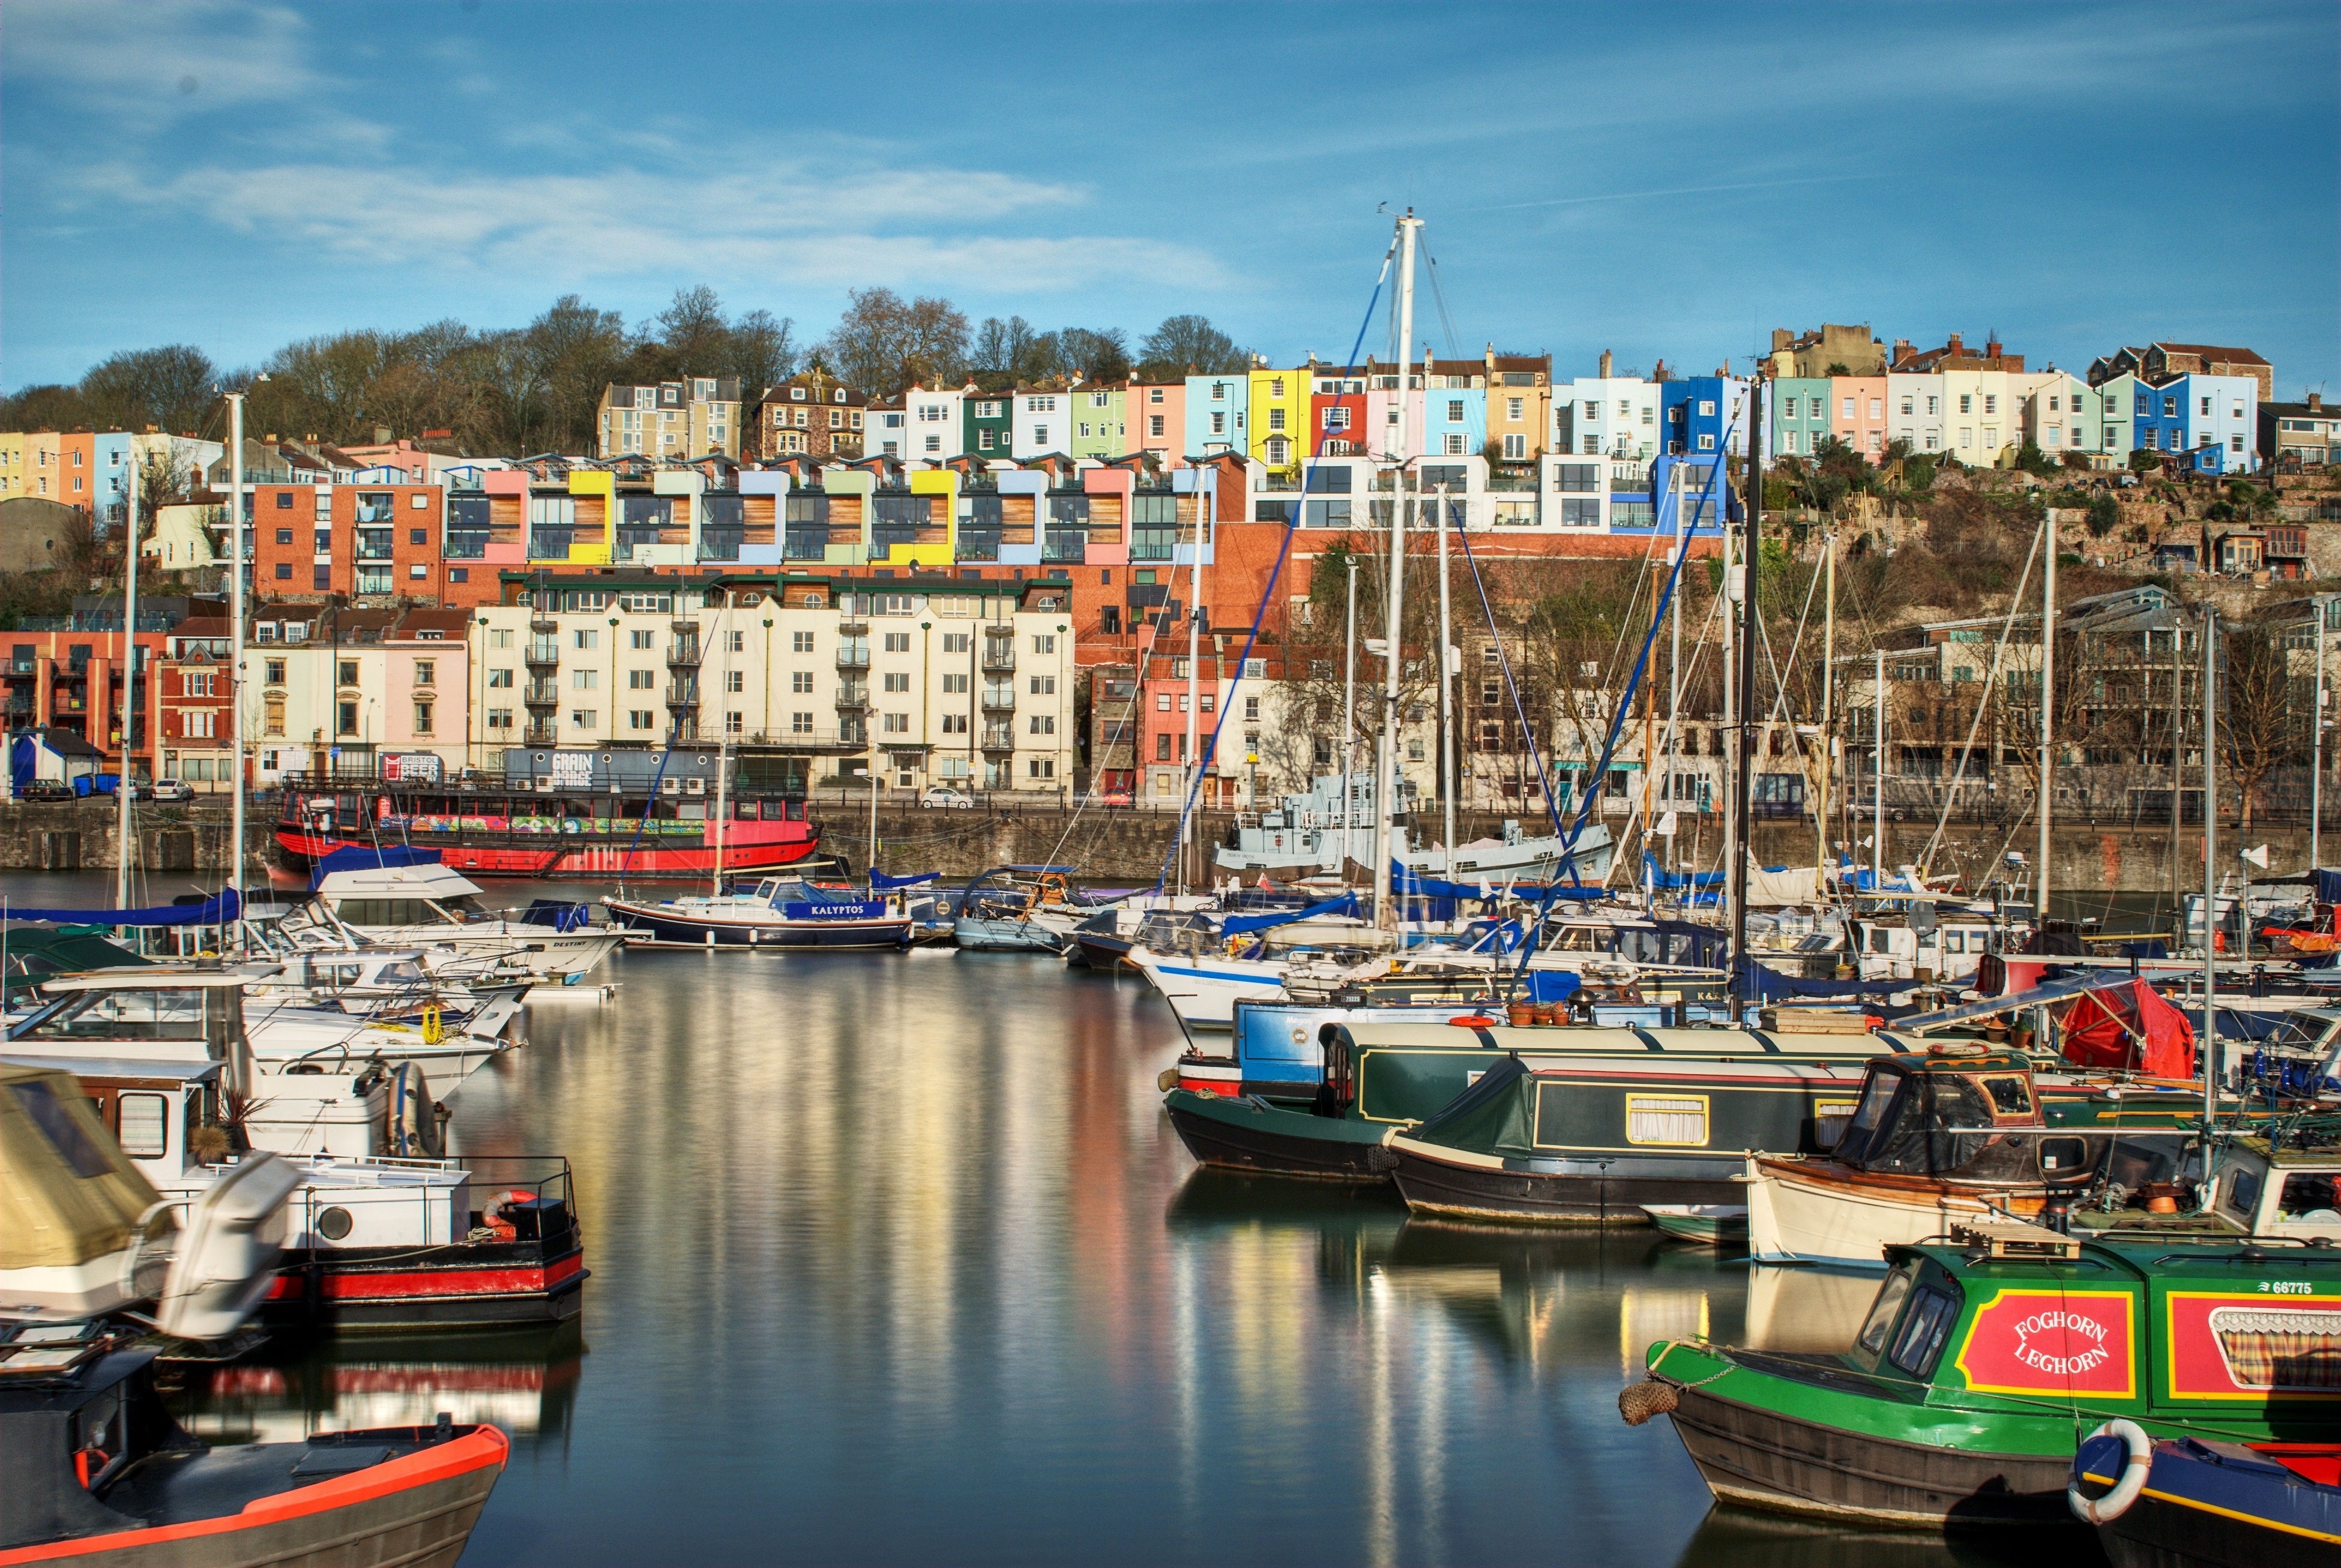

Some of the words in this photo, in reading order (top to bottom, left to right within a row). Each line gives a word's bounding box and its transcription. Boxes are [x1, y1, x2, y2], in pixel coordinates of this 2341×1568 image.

[552, 753, 593, 771] GRAIN
[400, 764, 438, 776] BEER
[552, 770, 593, 786] BARGE
[812, 906, 864, 915] KALYPTOS
[1697, 992, 1705, 1000] K
[2273, 1281, 2313, 1294] 66775
[2014, 1311, 2109, 1342] FOGHORN
[2014, 1342, 2109, 1374] LEGHORN
